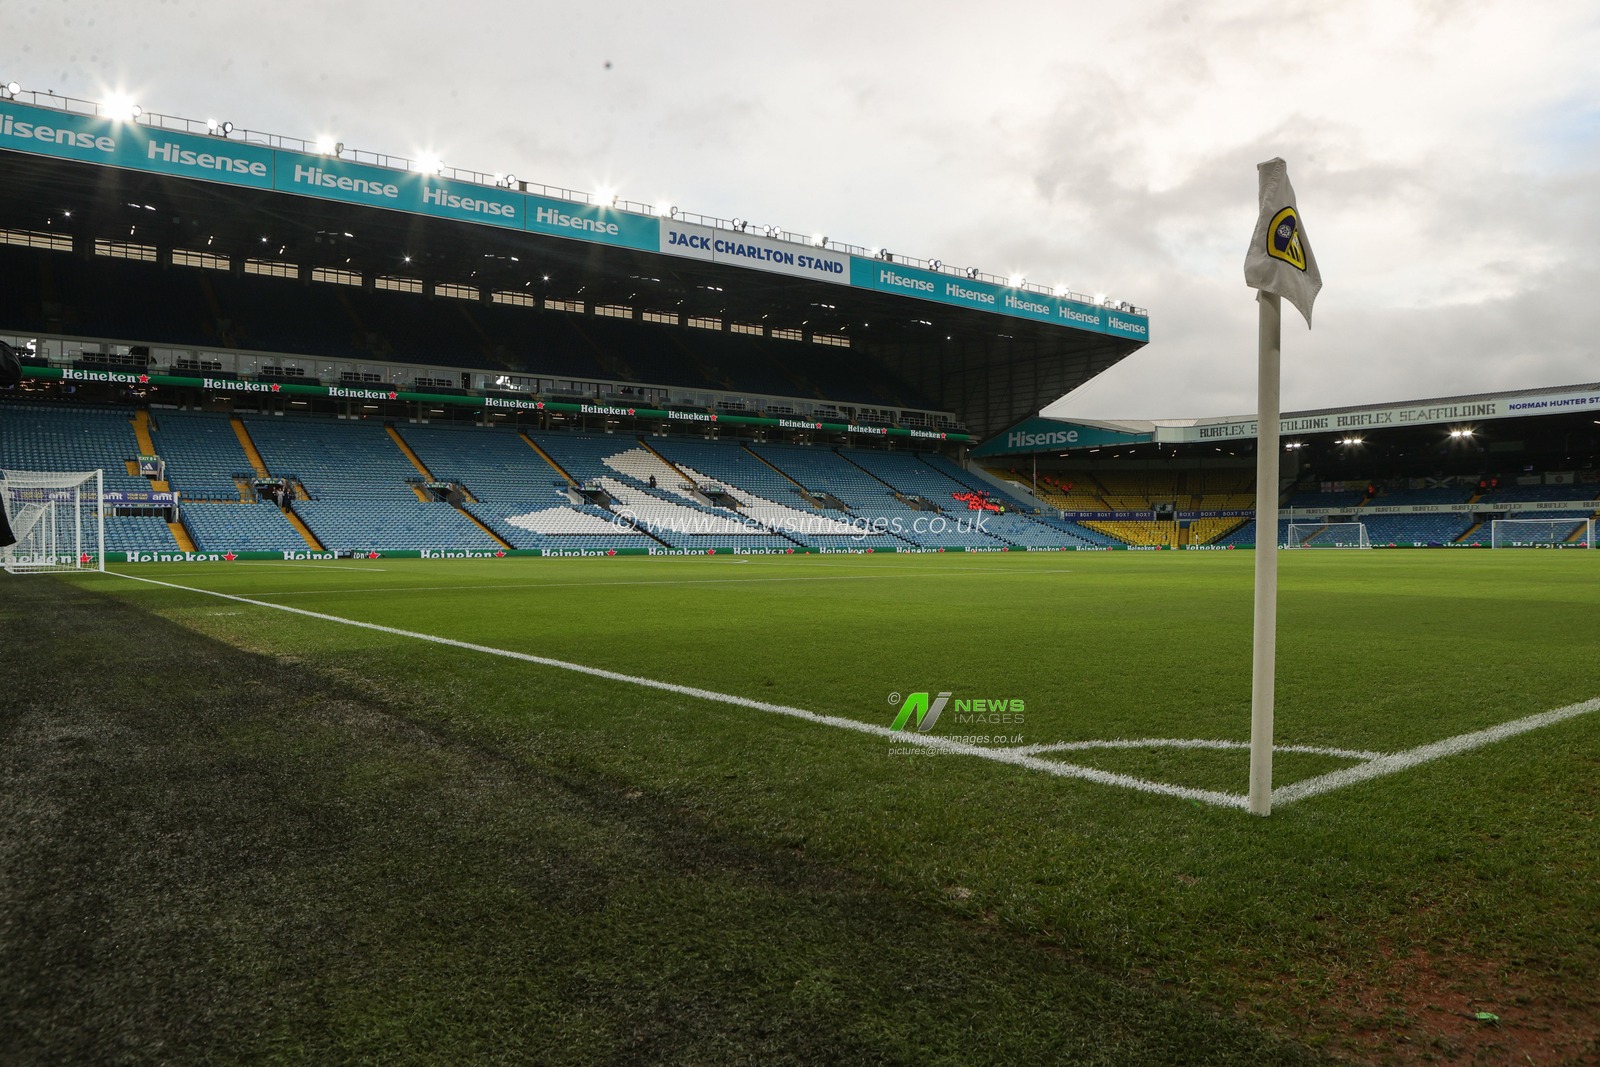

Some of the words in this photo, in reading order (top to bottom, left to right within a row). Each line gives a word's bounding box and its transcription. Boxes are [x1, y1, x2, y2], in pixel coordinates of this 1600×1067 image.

[147, 140, 267, 177] Hisense
[294, 163, 399, 199] Hisense
[422, 186, 516, 219] Hisense
[536, 206, 619, 236] Hisense
[668, 231, 711, 252] JACK
[714, 239, 794, 266] CHARLTON
[797, 254, 843, 275] STAND
[879, 269, 935, 293] Hisense
[945, 282, 995, 305] Hisense
[1004, 295, 1050, 315] Hisense
[1058, 306, 1100, 326] Hisense
[1107, 315, 1146, 335] Hisense
[62, 368, 137, 384] Heineken
[203, 378, 269, 392] Heineken
[328, 387, 387, 400] Heineken
[484, 397, 535, 410] Heineken
[580, 404, 628, 416] Heineken
[1509, 401, 1548, 411] NORMAN
[1550, 397, 1586, 407] HUNTER
[1589, 396, 1600, 404] ST
[667, 410, 713, 422] Heineken
[1337, 411, 1392, 427] BURFLEX
[1400, 403, 1496, 422] SCAFFOLDING
[779, 419, 816, 430] Heineken
[847, 424, 881, 434] Heineken
[1200, 424, 1245, 439] BURFLEX
[910, 429, 941, 439] Heineken
[1007, 427, 1079, 448] Hisense
[152, 492, 172, 501] amt
[126, 551, 219, 563] Heineken
[420, 550, 491, 559] Heineken
[541, 549, 604, 557] Heineken
[648, 548, 705, 556] Heineken
[733, 547, 784, 555] Heineken
